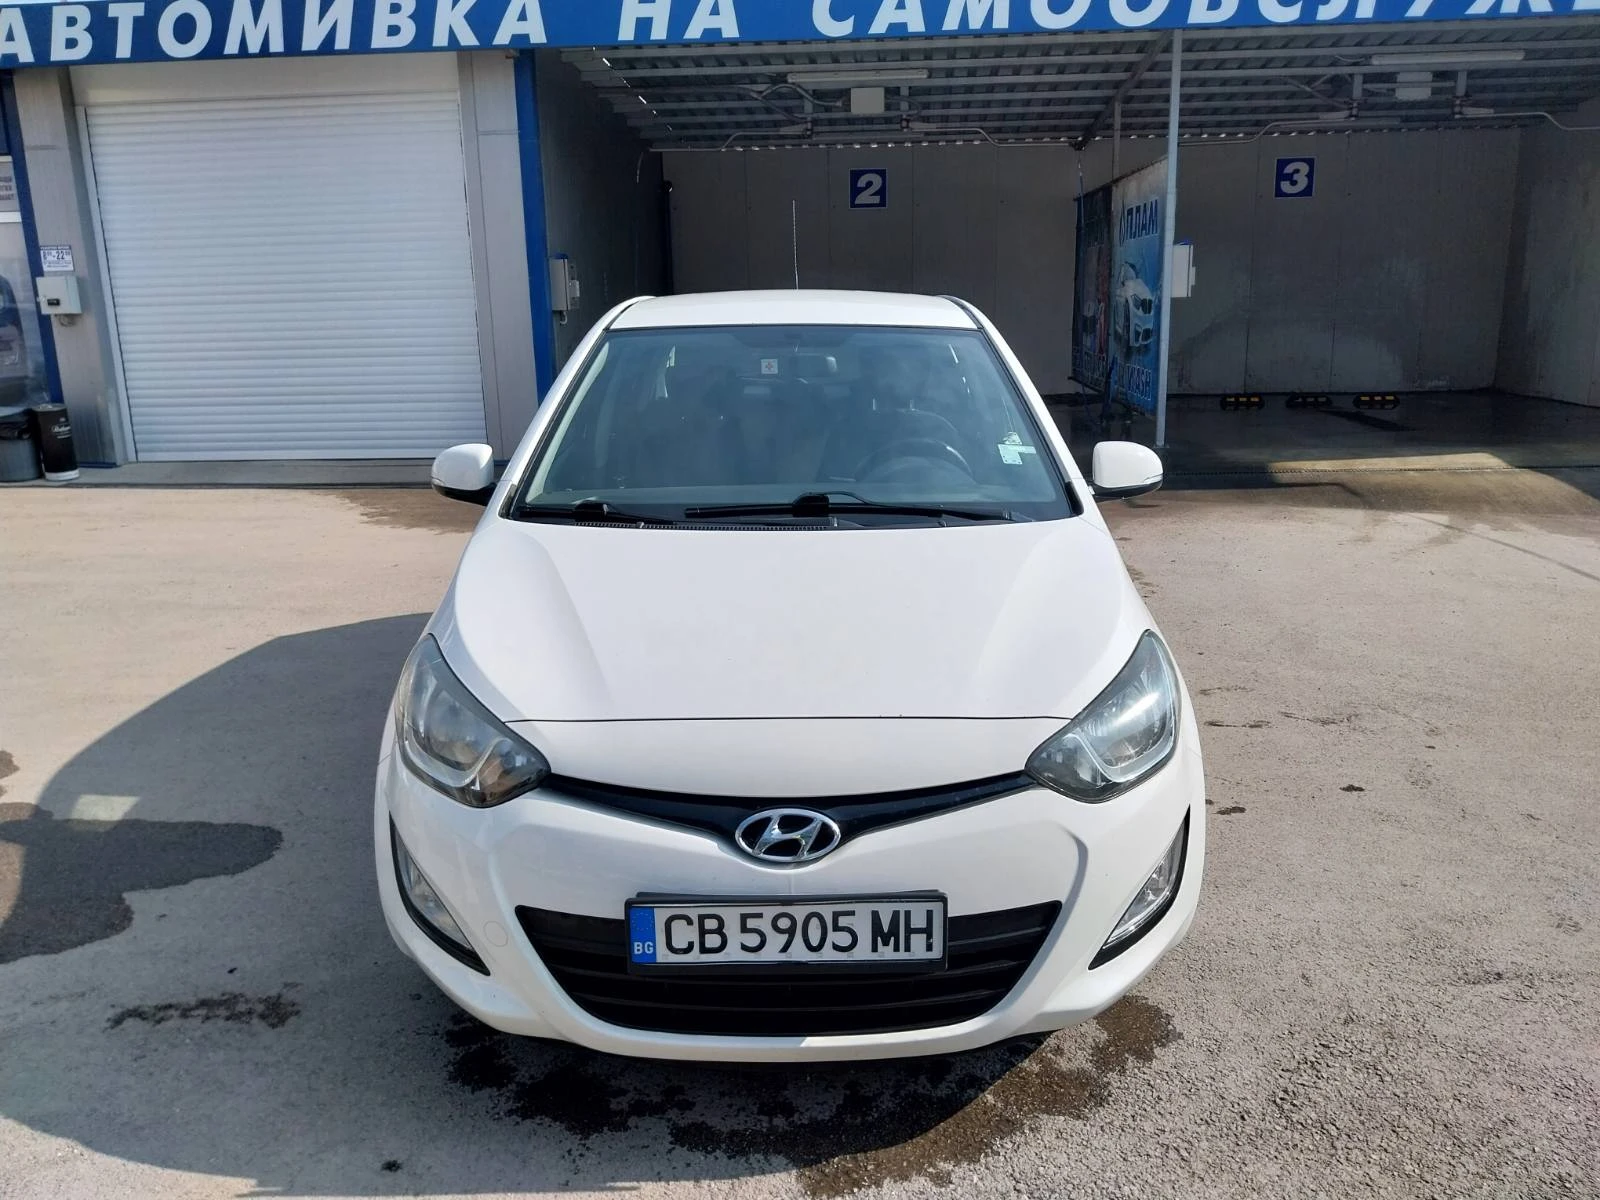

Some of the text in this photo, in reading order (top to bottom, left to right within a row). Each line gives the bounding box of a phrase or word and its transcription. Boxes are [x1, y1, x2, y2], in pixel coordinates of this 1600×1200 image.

[0, 0, 548, 62] АВТОМИВКА
[617, 0, 739, 41] НА
[854, 173, 882, 205] 2
[1280, 161, 1309, 194] 3
[1126, 199, 1158, 240] ПЛАМ
[633, 942, 654, 954] BG
[664, 909, 934, 955] CB 5905 MH
